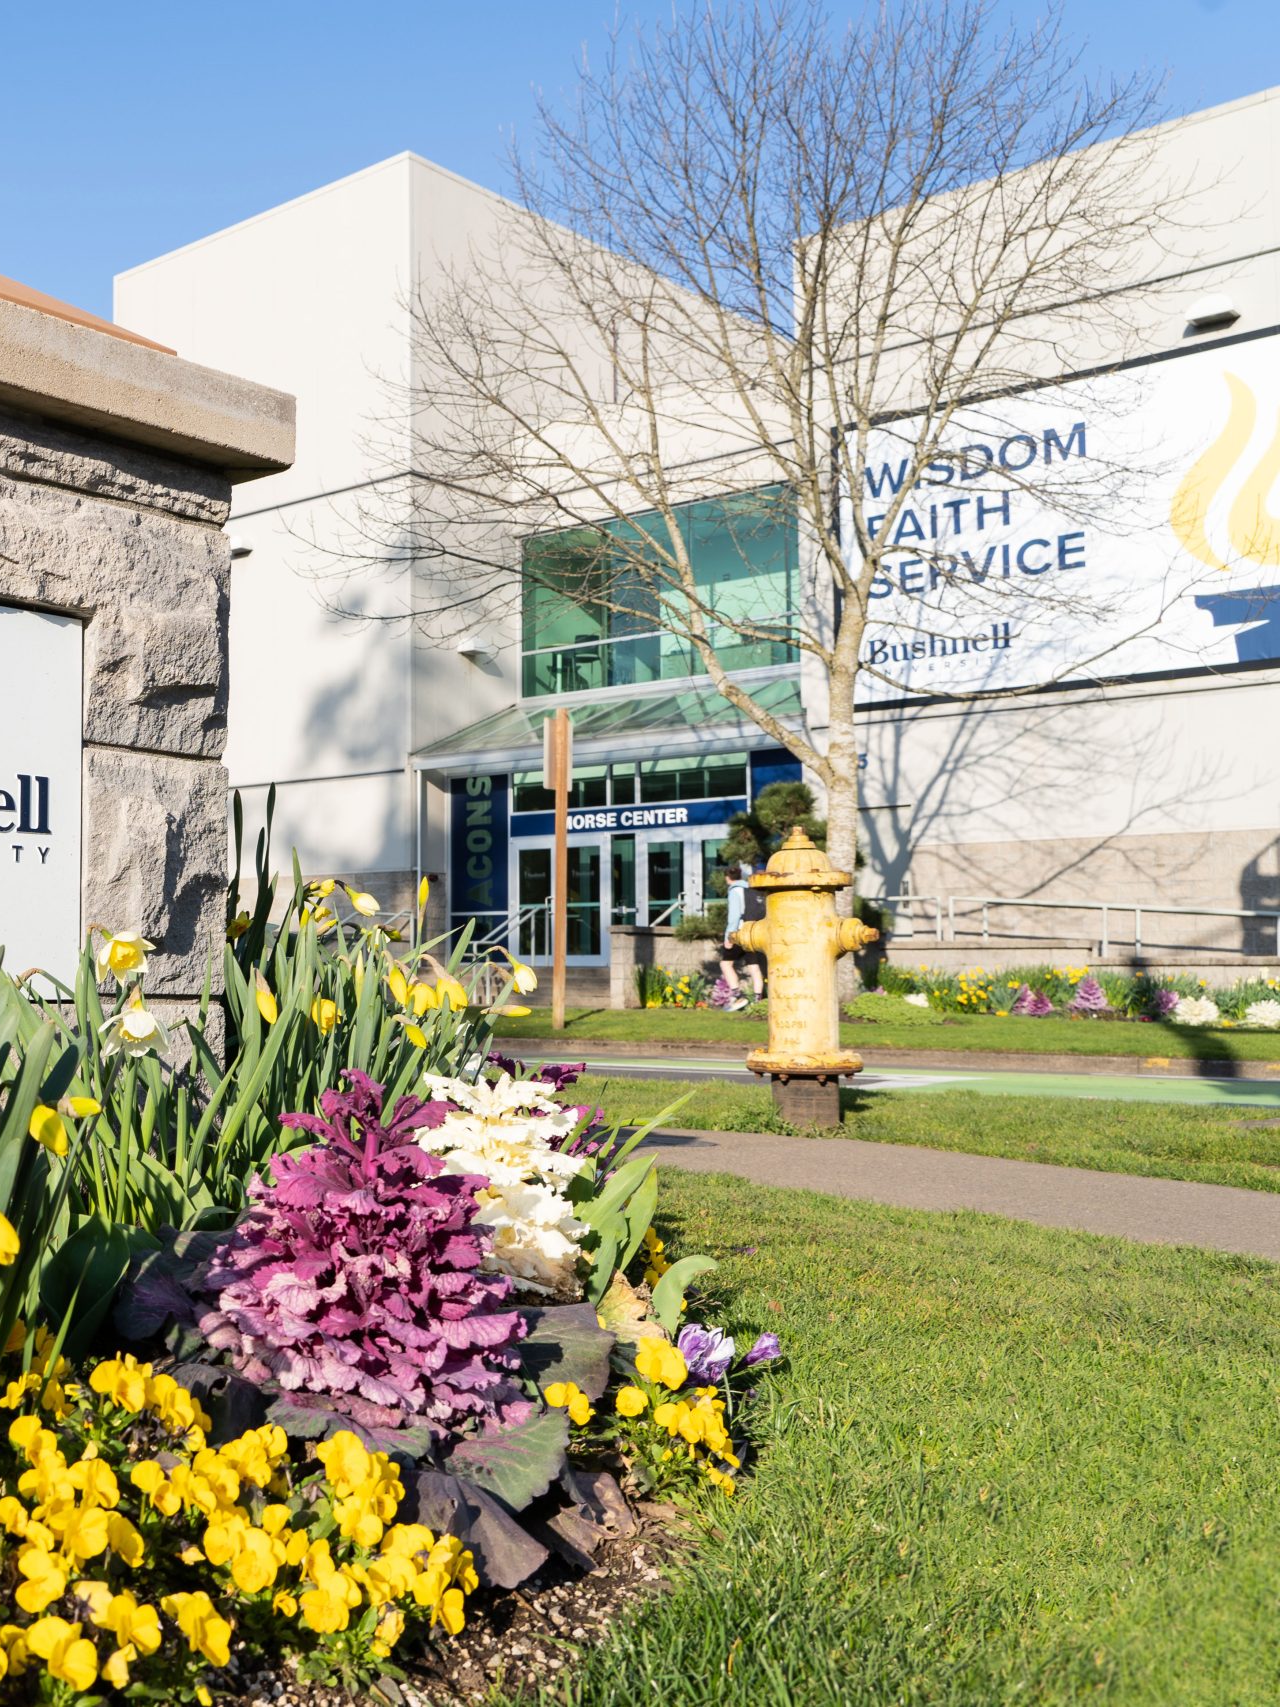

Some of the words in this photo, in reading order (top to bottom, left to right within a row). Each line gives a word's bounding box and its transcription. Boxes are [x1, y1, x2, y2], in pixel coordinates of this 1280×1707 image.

[867, 490, 1010, 544] FAITH
[867, 531, 1087, 600] SERVICE
[867, 622, 1012, 666] Bushnell
[870, 654, 1011, 679] NIVERSITY
[620, 807, 688, 826] CENTER
